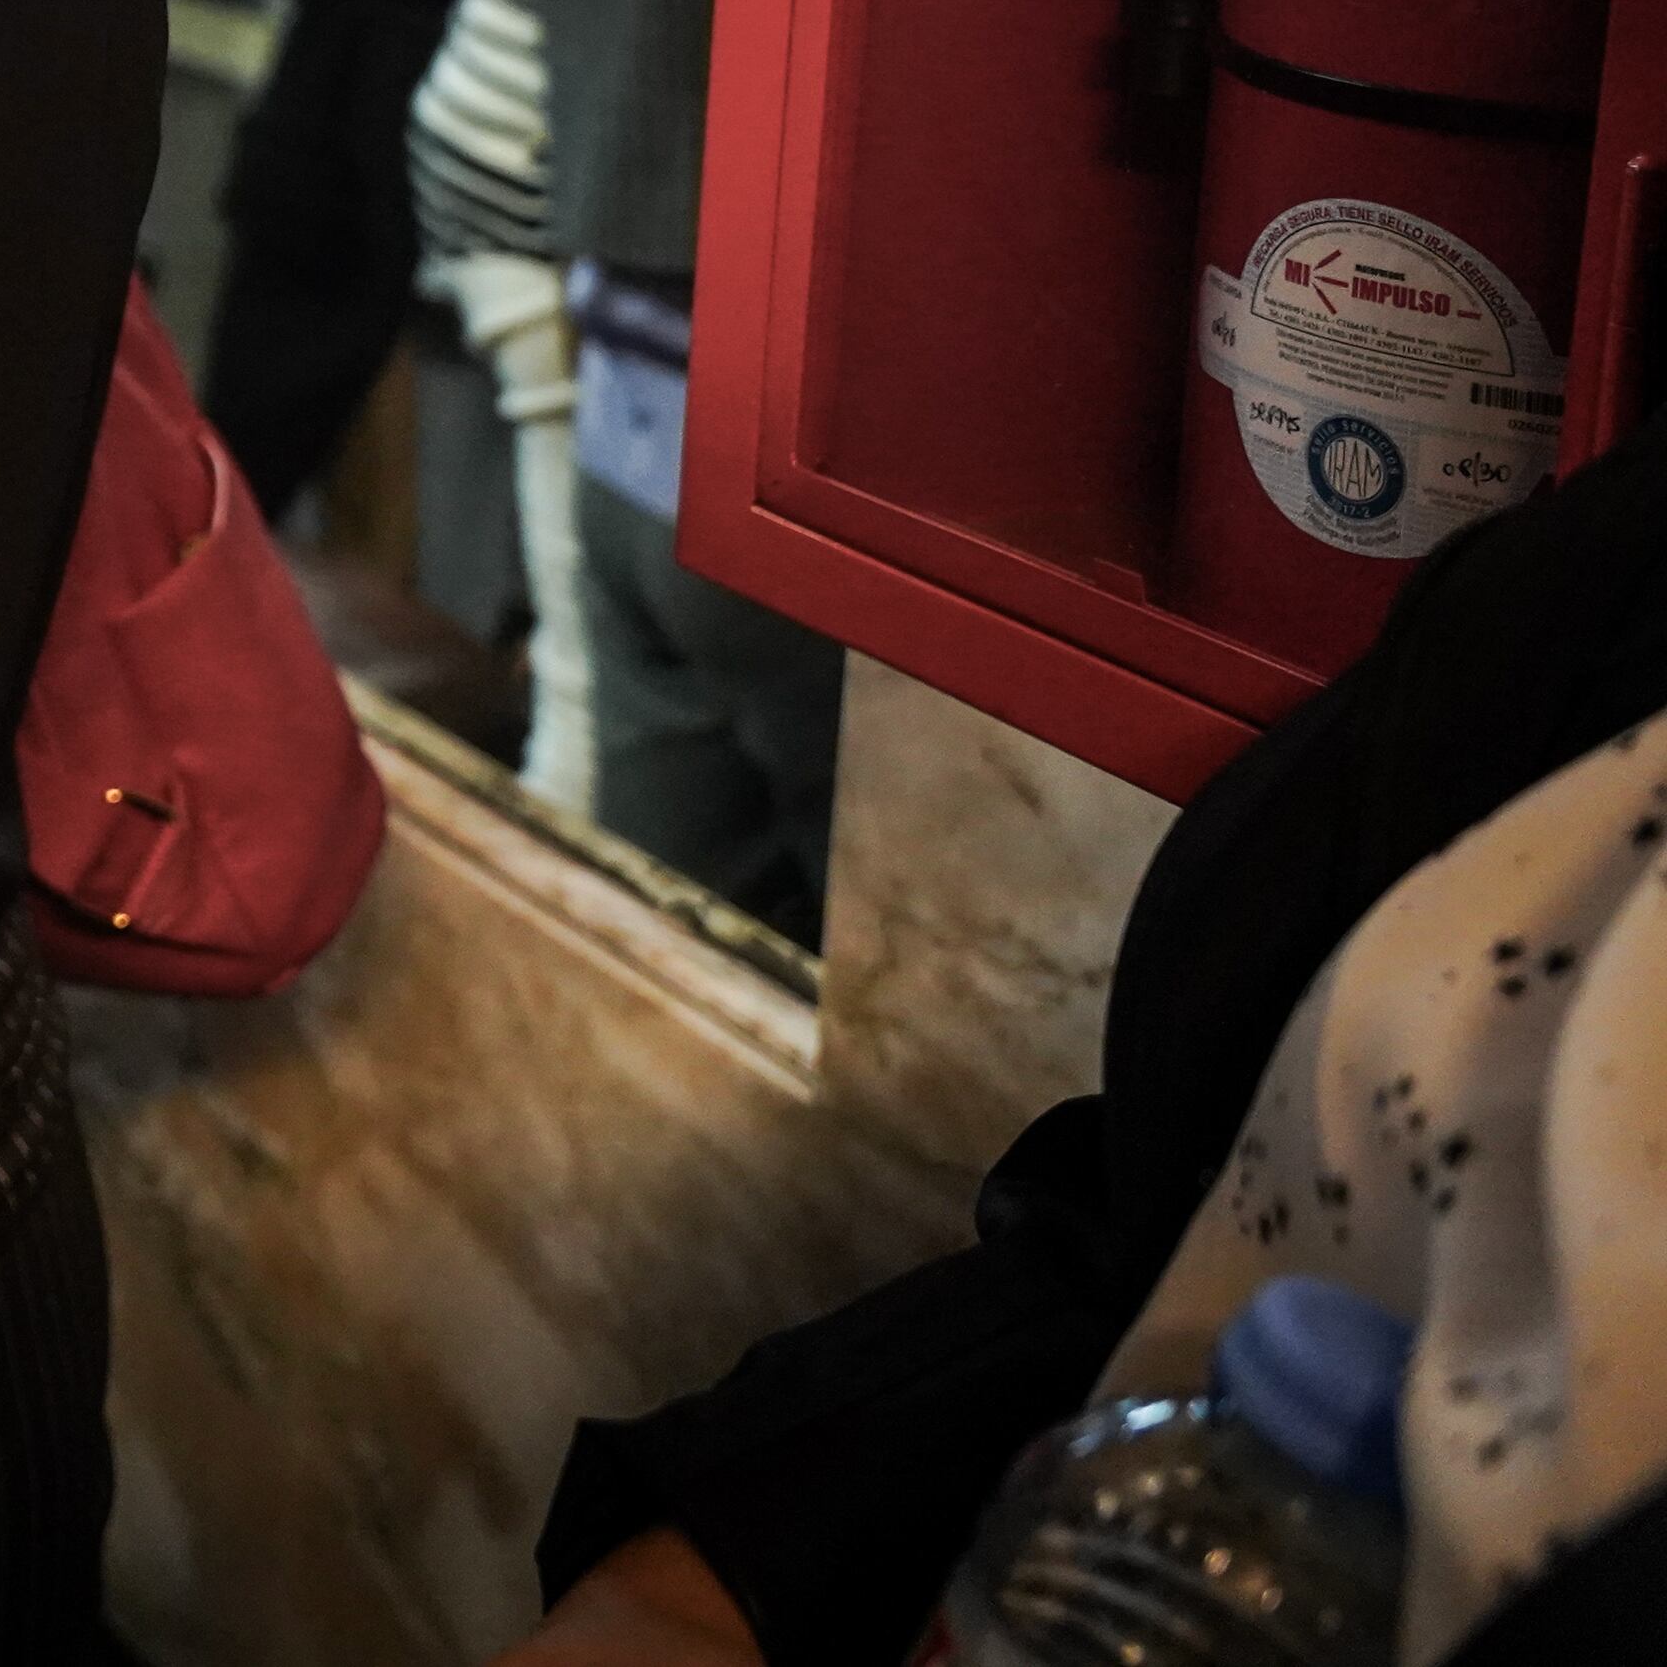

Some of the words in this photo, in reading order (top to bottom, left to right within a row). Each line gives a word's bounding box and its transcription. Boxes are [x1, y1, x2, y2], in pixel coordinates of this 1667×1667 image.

[1351, 276, 1451, 317] IMPULSO
[1378, 212, 1424, 239] SELLO
[1424, 234, 1462, 264] IRAM
[1460, 260, 1518, 328] SERVICIOS
[1327, 438, 1382, 498] IRAM
